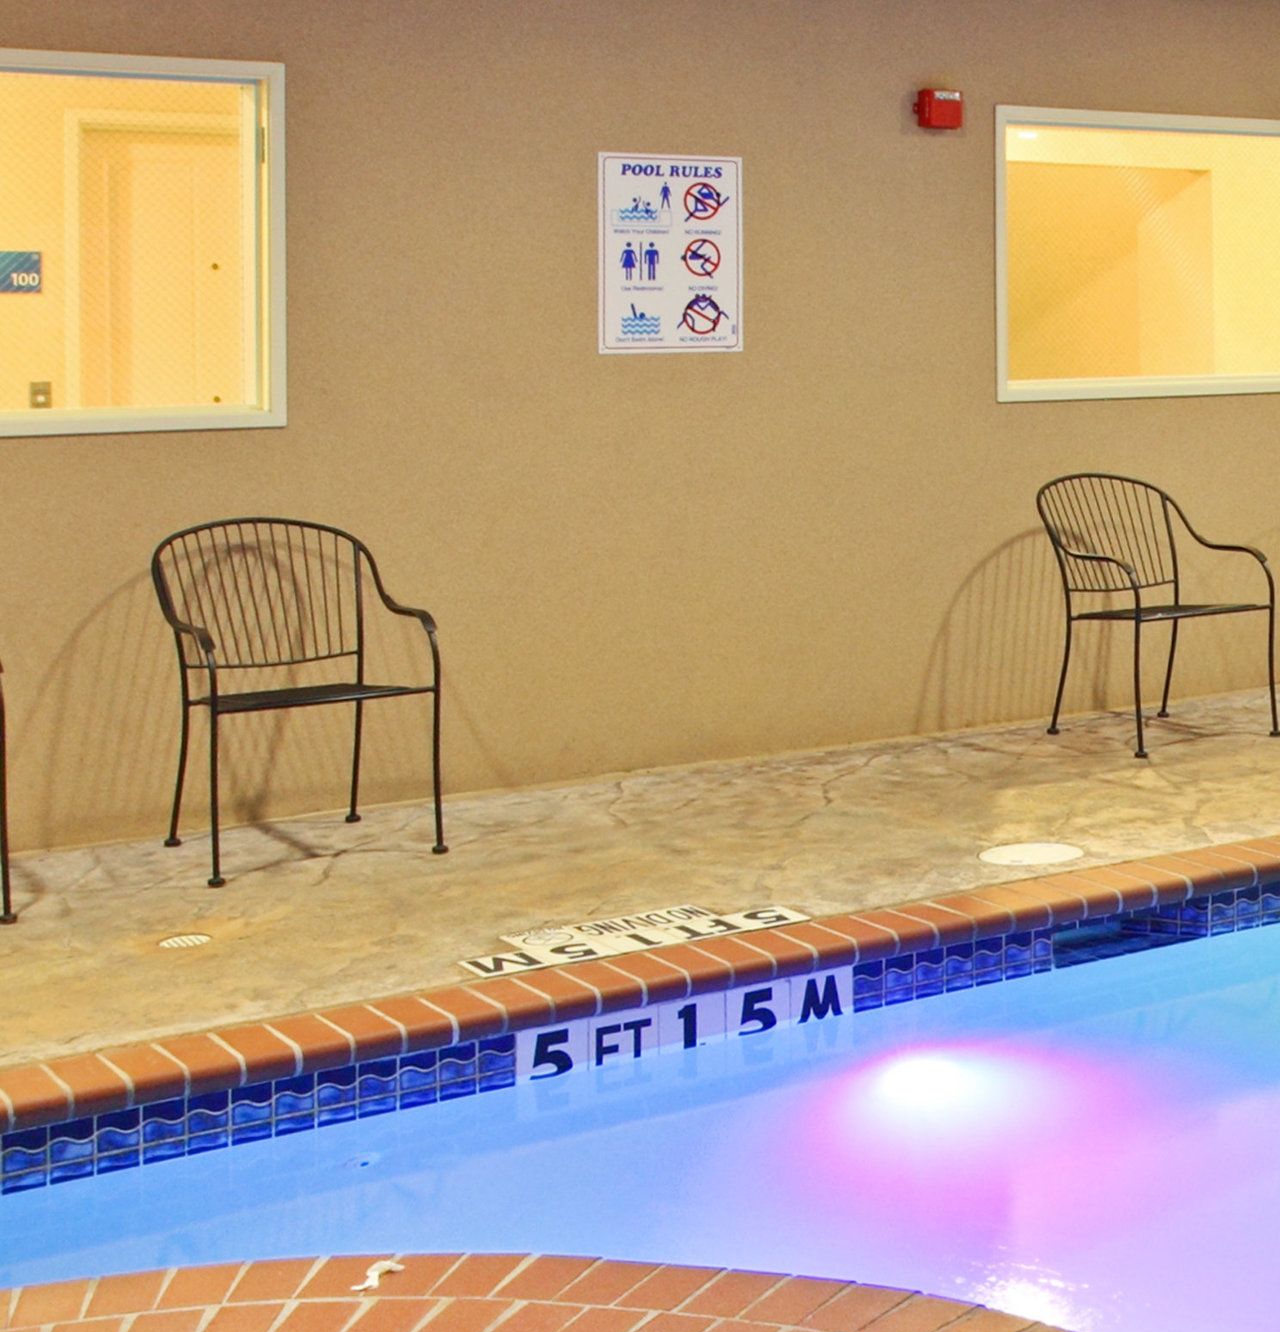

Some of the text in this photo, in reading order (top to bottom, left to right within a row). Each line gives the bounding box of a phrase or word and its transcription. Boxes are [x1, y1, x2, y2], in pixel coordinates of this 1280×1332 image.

[621, 163, 723, 179] POOL RULES
[10, 272, 39, 287] 100
[670, 905, 708, 920] NO
[742, 908, 790, 925] 5
[575, 912, 670, 937] DIVING
[549, 943, 599, 960] 5
[467, 951, 544, 974] M
[529, 1028, 574, 1081] 5
[594, 1017, 653, 1067] FT
[738, 987, 778, 1037] 5
[797, 974, 843, 1025] M
